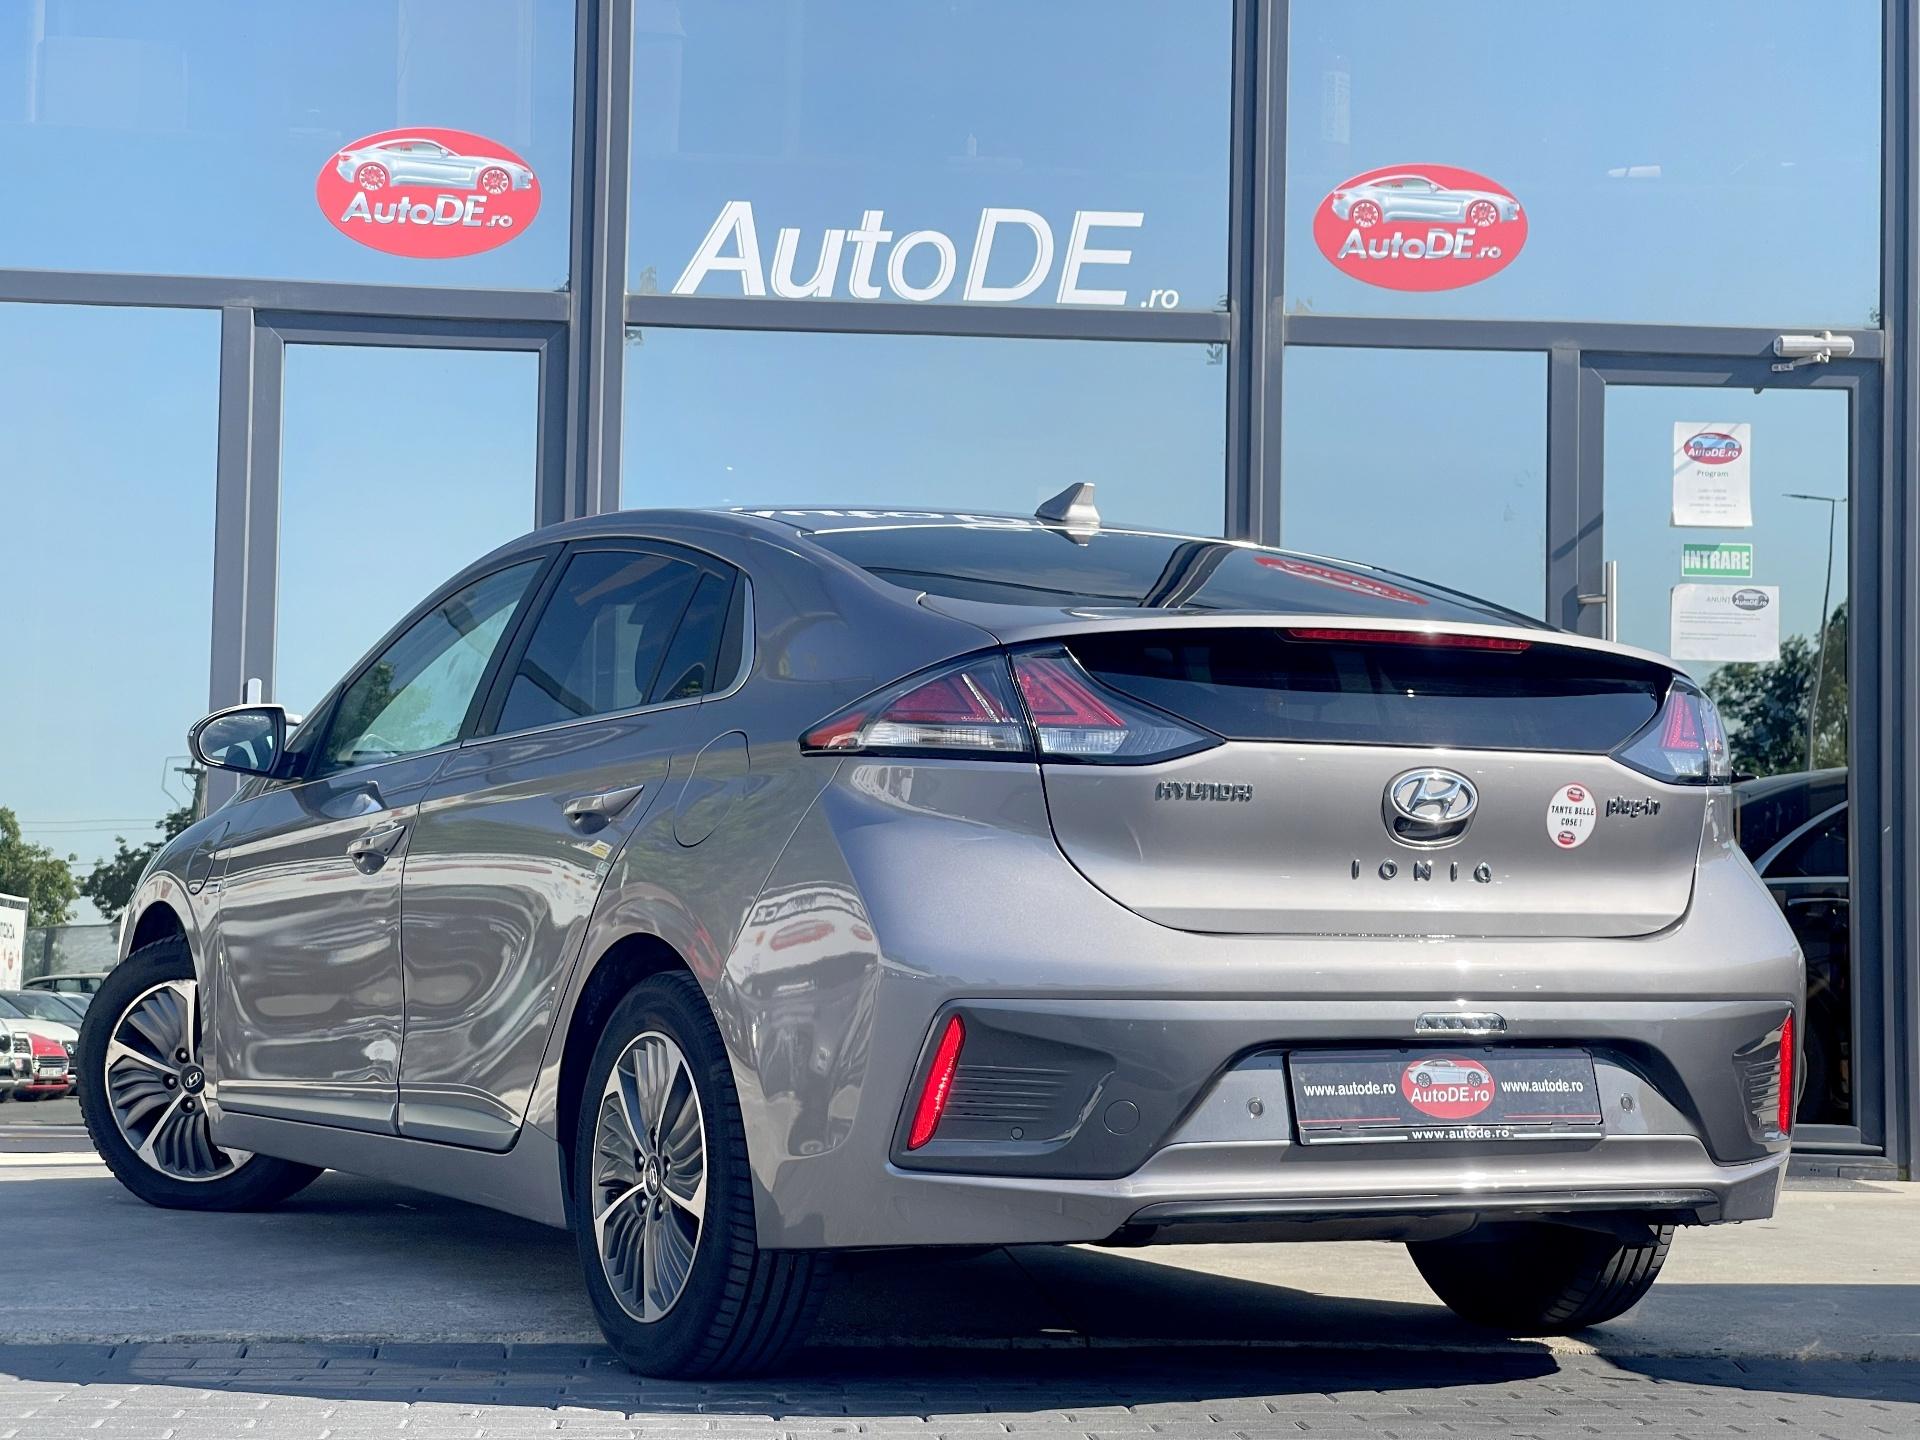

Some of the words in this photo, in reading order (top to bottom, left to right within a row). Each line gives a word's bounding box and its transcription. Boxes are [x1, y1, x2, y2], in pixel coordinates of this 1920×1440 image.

[341, 191, 513, 228] AutoDE.ro
[1337, 227, 1502, 260] AutoDE.ro
[1687, 447, 1739, 457] AutoDE.ro
[1696, 469, 1729, 478] Program
[1684, 550, 1750, 570] INTRARE
[1155, 781, 1253, 802] HYUNDAI
[1551, 805, 1573, 814] TANTE
[1575, 807, 1595, 815] BELLE
[1606, 796, 1661, 818] plug-in
[1561, 818, 1577, 826] COSE
[1351, 858, 1492, 883] IONIQ
[1303, 1080, 1396, 1097] www.autode.ro
[1500, 1077, 1584, 1093] www.autode.ro
[1410, 1086, 1490, 1103] AutoDE.ro
[1411, 1127, 1510, 1140] www.autode.ro
